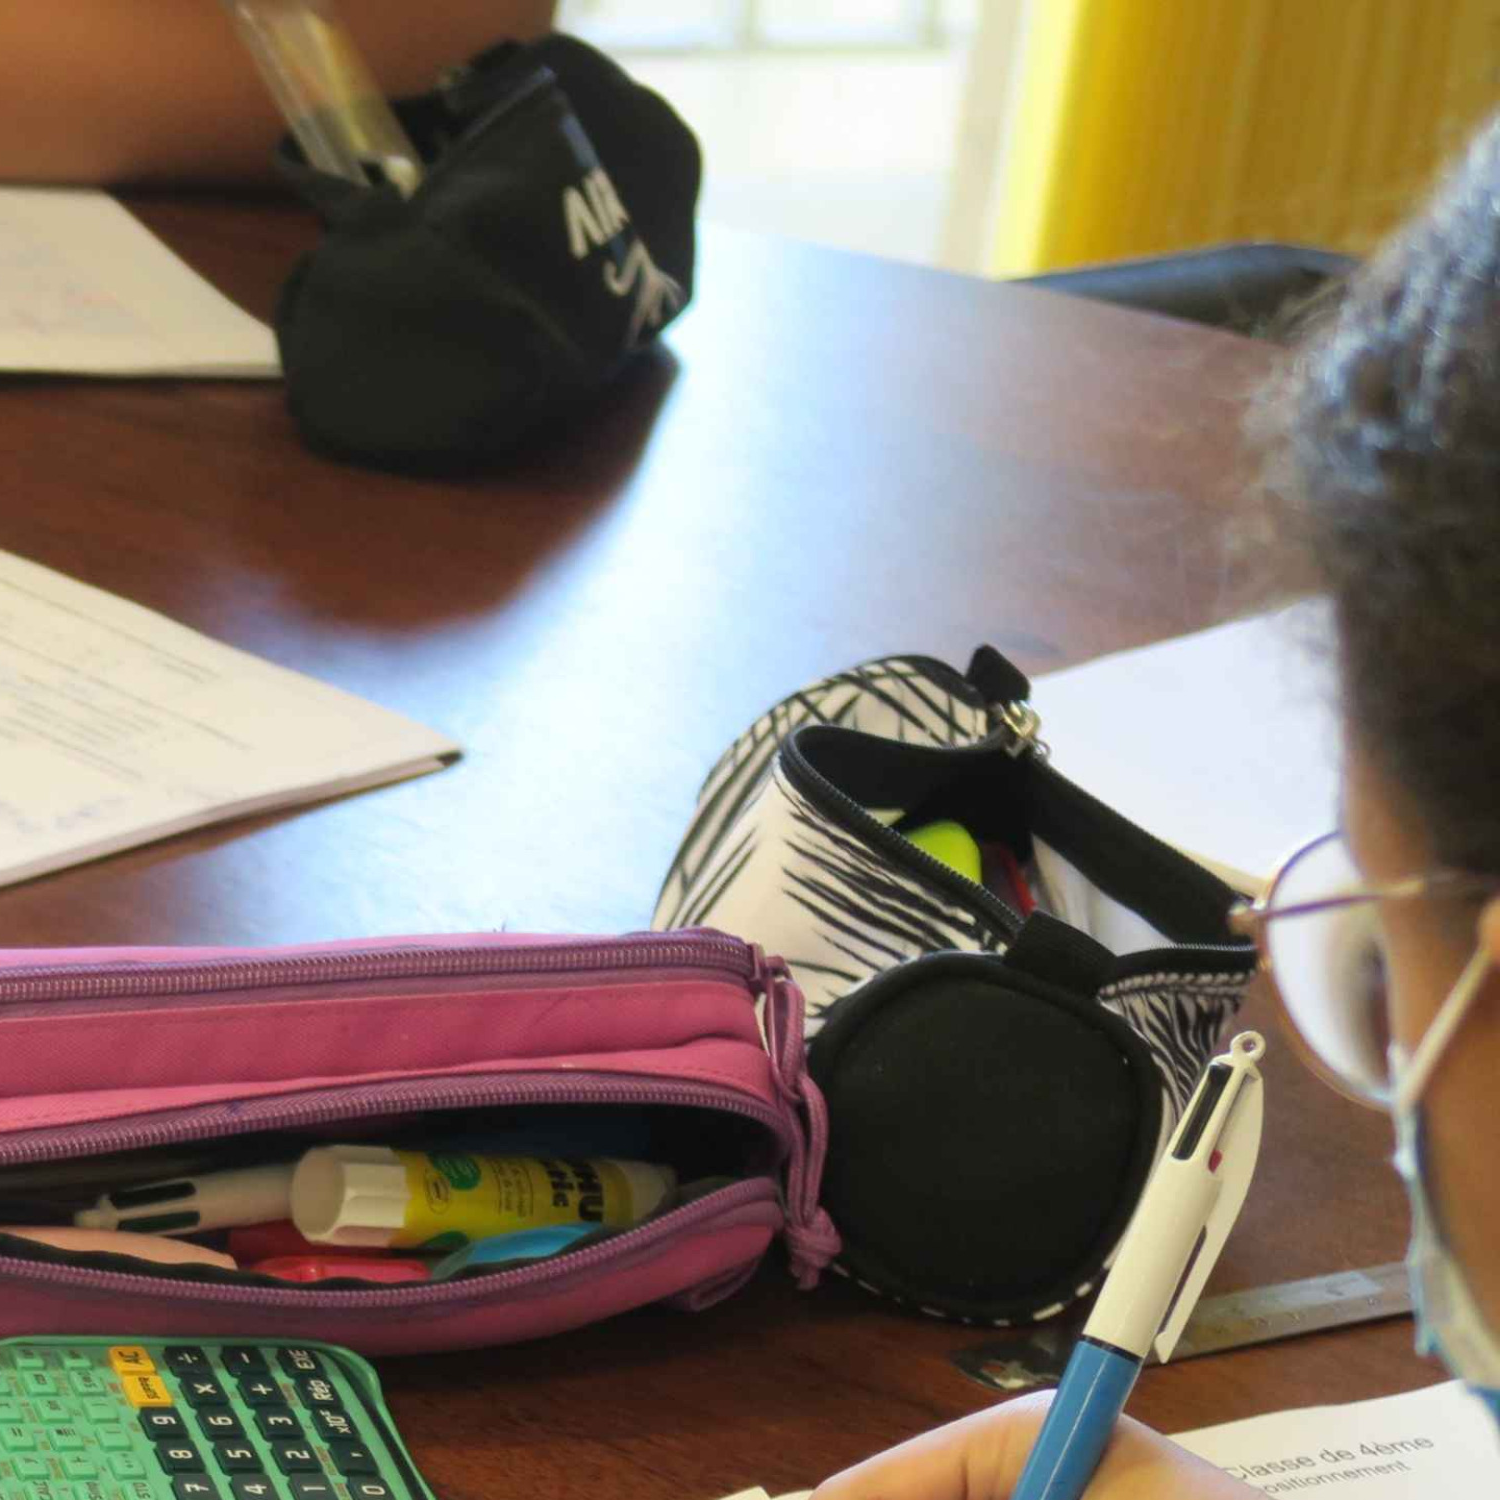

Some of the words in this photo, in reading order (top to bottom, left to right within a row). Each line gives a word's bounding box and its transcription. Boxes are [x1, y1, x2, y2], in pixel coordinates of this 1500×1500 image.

[117, 1351, 144, 1366] AC
[288, 1349, 315, 1370] EXE
[307, 1379, 334, 1401] Rép
[152, 1414, 176, 1426] 9
[207, 1415, 234, 1427] 6
[267, 1415, 293, 1426] 3
[169, 1448, 193, 1460] 8
[227, 1448, 252, 1459] 5
[285, 1449, 311, 1460] 2
[1320, 1447, 1356, 1464] de
[1360, 1437, 1434, 1457] 4ème
[1262, 1459, 1412, 1494] ositionnement
[184, 1482, 209, 1493] 7
[243, 1482, 268, 1496] 4
[302, 1484, 326, 1492] 1
[361, 1484, 386, 1496] 0
